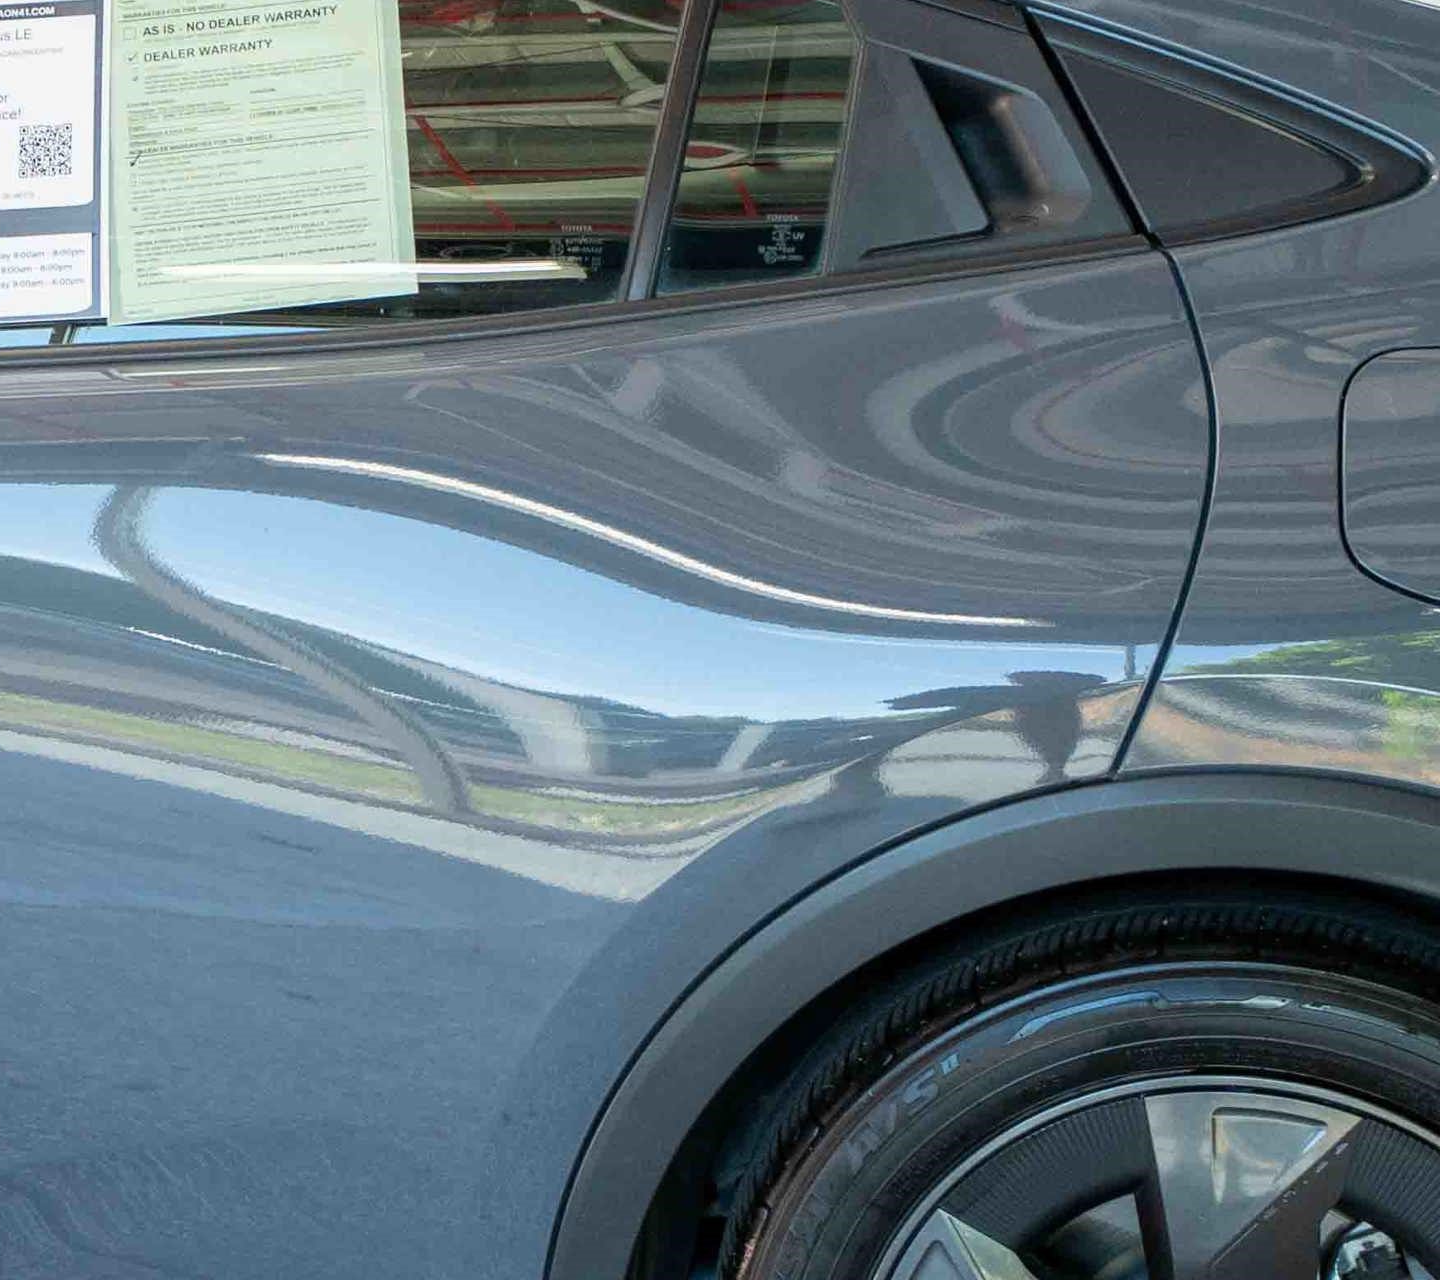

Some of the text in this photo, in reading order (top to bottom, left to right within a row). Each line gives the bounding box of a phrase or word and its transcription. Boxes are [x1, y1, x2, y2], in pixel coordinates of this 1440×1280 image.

[143, 25, 159, 37] AS
[163, 24, 174, 34] IS
[187, 21, 205, 32] NO
[209, 14, 260, 30] DEALER
[264, 5, 338, 23] WARRANTY
[15, 29, 32, 41] LE
[144, 39, 273, 62] DEALER WARRANTY
